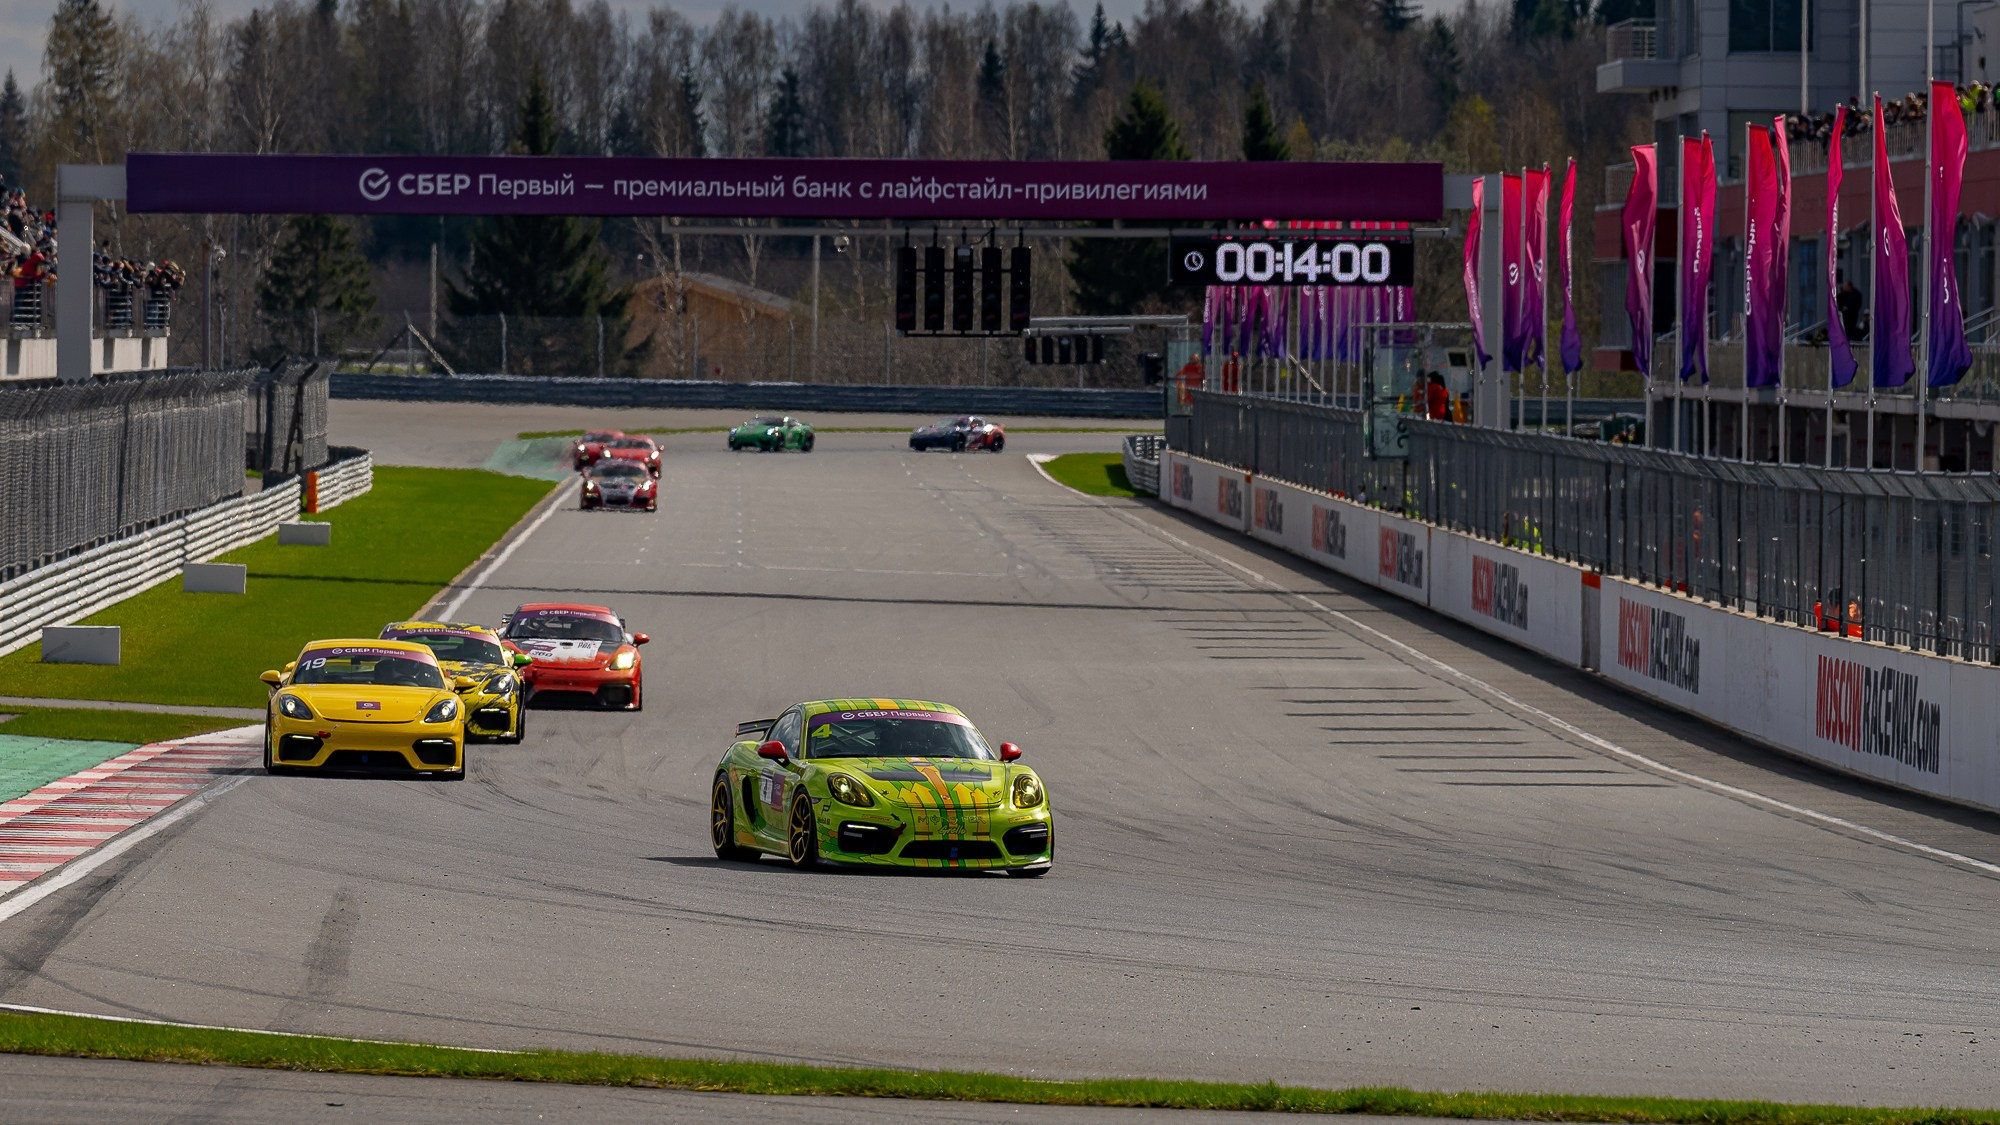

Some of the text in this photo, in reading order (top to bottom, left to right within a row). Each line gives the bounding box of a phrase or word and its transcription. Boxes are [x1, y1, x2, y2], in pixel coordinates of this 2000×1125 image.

[398, 174, 470, 196] СБЕР
[478, 173, 575, 199] Первый
[613, 175, 785, 200] премиальный
[793, 176, 852, 199] банк
[859, 181, 873, 198] с
[878, 176, 1208, 204] лайфстайл-привилегиями
[1216, 242, 1390, 283] 00:14:00
[371, 648, 406, 656] Первый
[301, 657, 327, 672] 19
[890, 711, 932, 719] Первый
[811, 723, 832, 738] 4
